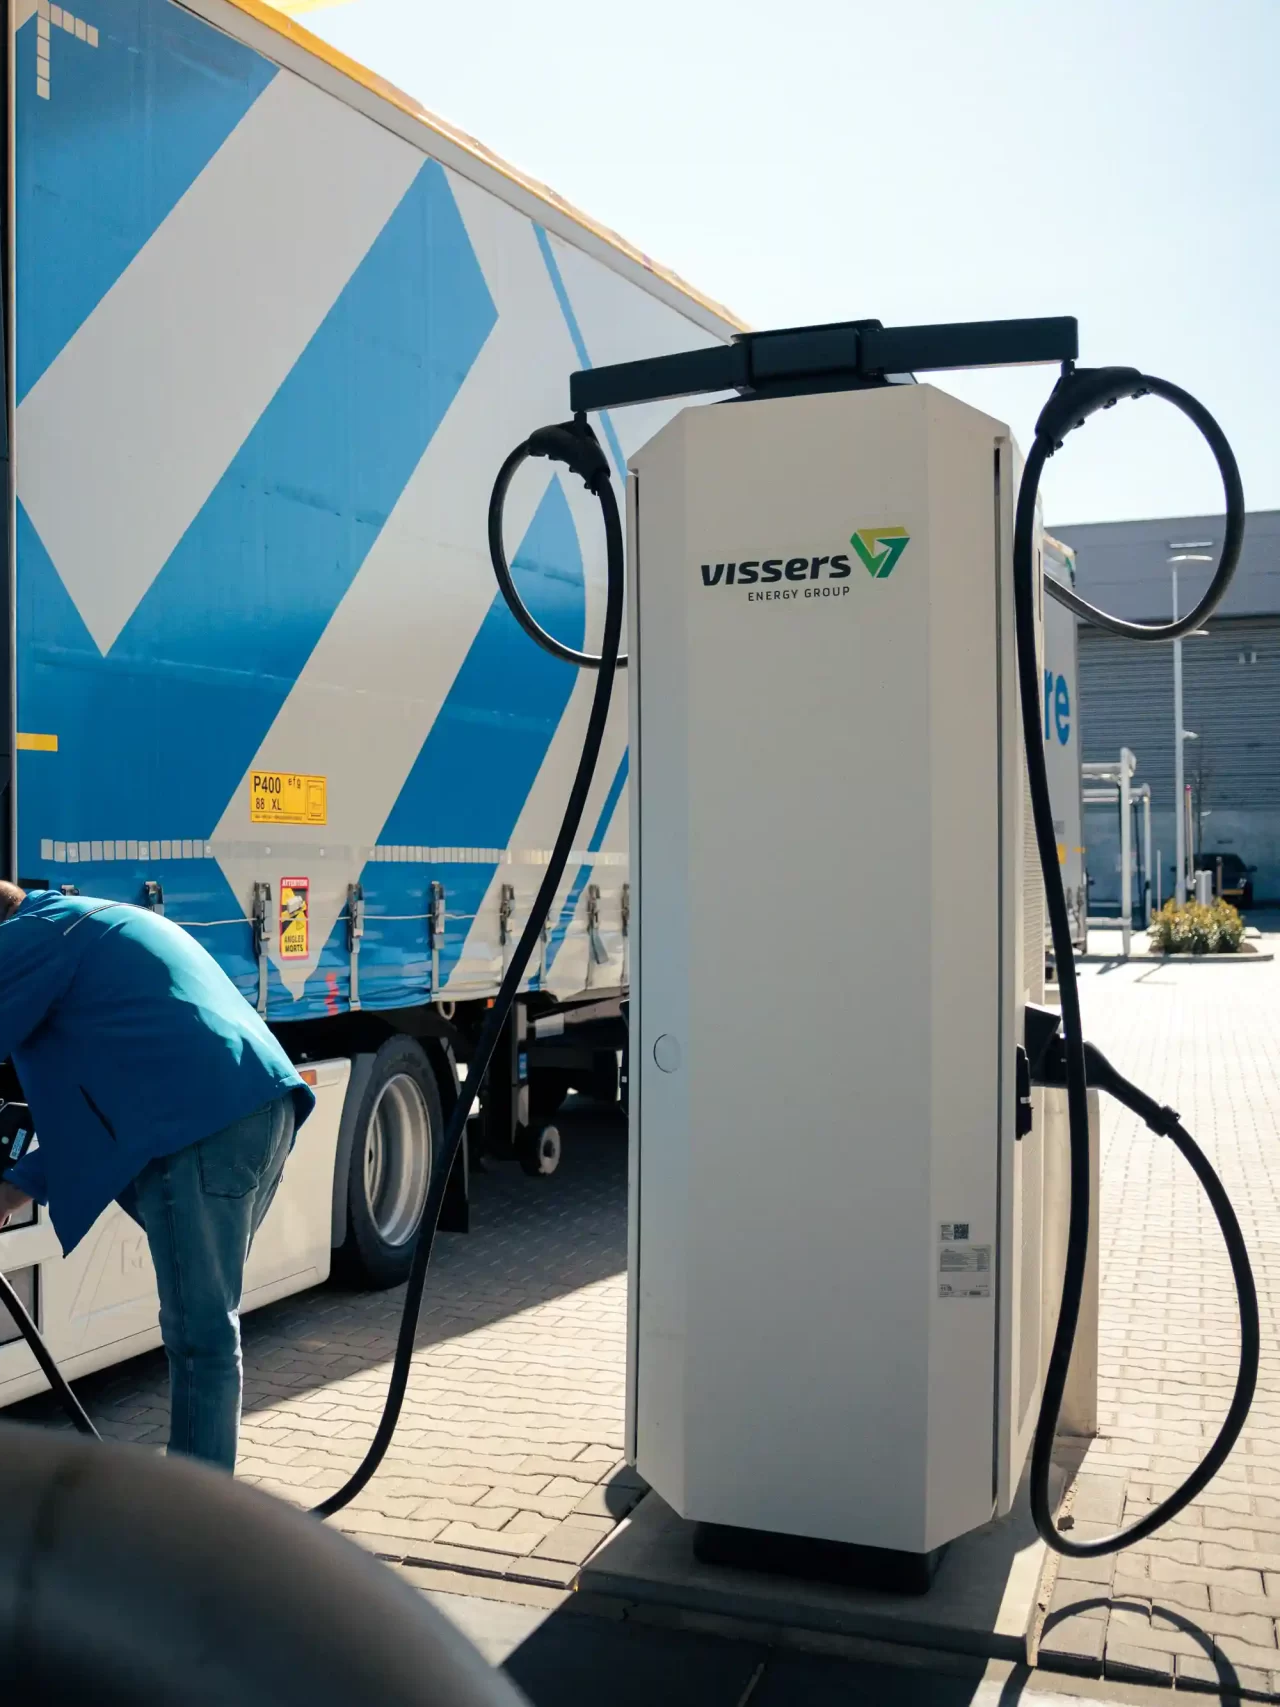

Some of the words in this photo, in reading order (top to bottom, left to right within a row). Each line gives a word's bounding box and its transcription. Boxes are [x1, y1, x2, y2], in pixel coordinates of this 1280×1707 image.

[748, 589, 799, 602] ENERGY
[804, 586, 850, 598] GROUP
[253, 776, 281, 794] P400
[255, 797, 265, 810] 88
[272, 798, 282, 810] XL
[284, 935, 304, 943] ANGLES
[285, 944, 303, 953] MORTS
